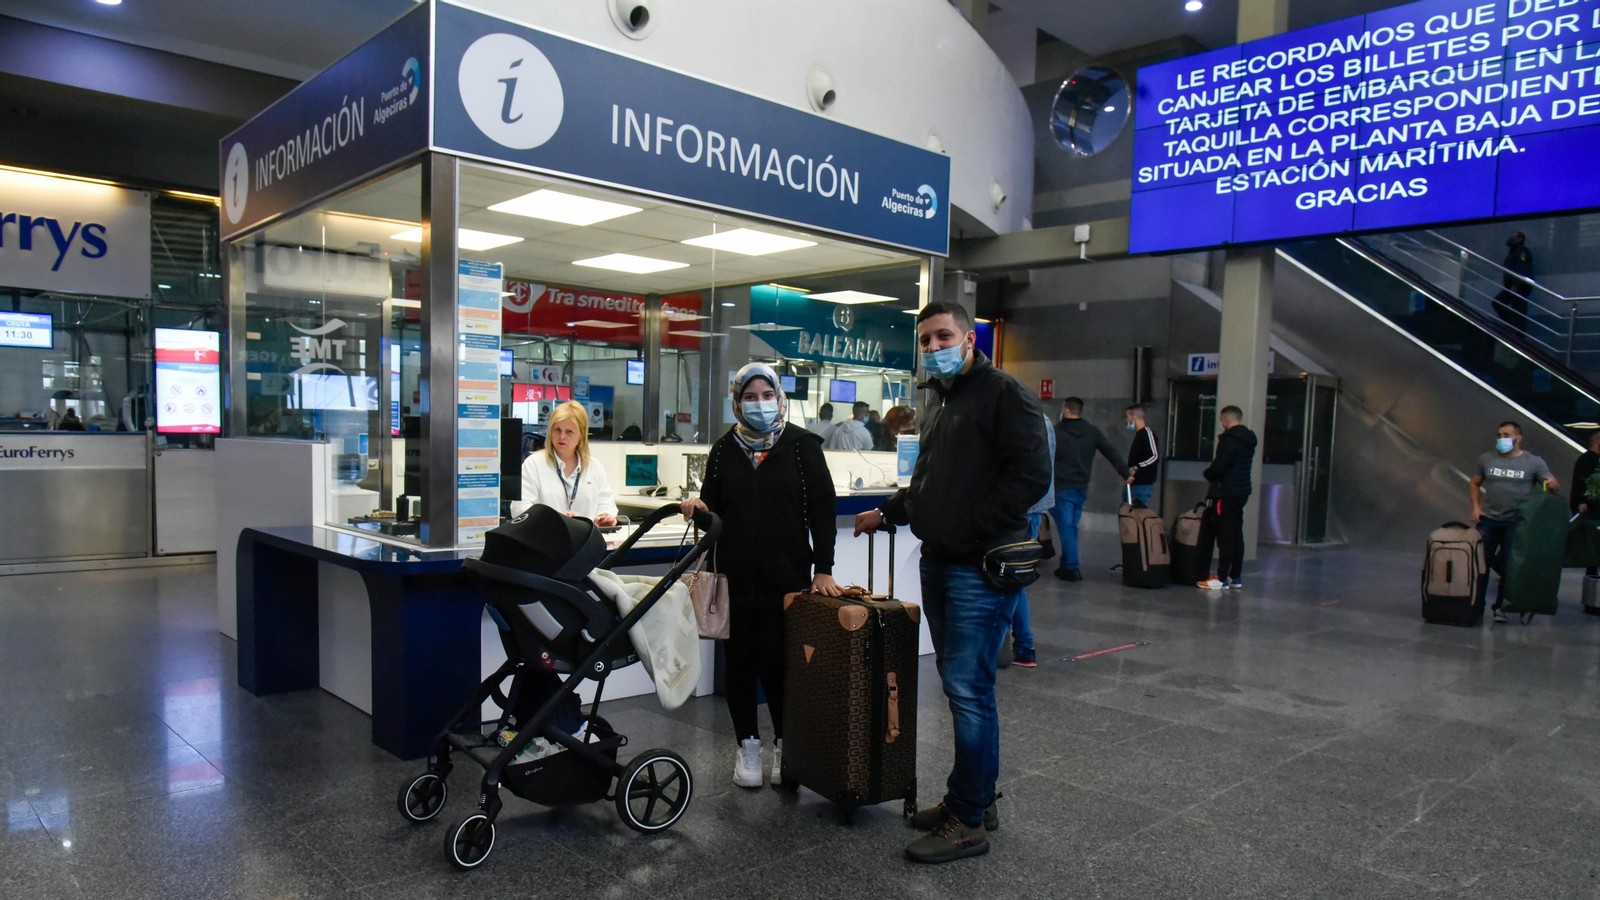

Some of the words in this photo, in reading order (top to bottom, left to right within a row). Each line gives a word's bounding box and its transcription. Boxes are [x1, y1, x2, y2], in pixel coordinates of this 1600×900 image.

[1158, 77, 1272, 115] CANJEAR
[1280, 64, 1335, 91] LOS
[1344, 32, 1490, 77] BILLETES
[1501, 14, 1580, 46] POR
[1177, 69, 1205, 90] LE
[1213, 22, 1415, 83] RECORDAMOS
[1425, 3, 1496, 35] QUE
[1508, 0, 1590, 18] DE
[373, 96, 408, 124] Algeciras
[381, 86, 399, 103] Puerto
[400, 80, 408, 91] de
[1165, 102, 1272, 135] TARJETA
[1278, 91, 1315, 115] DE
[1324, 55, 1502, 106] EMBARQUE
[1515, 44, 1563, 71] EN
[1576, 40, 1600, 60] L
[256, 95, 364, 192] INFORMACIÓN
[611, 103, 860, 205] INFORMACIÓN
[1138, 153, 1241, 183] SITUADA
[1247, 145, 1282, 166] EN
[1291, 139, 1324, 160] LA
[1331, 119, 1448, 153] PLANTA
[1455, 104, 1542, 134] BAJA
[1163, 123, 1282, 157] TAQUILLA
[1216, 158, 1349, 194] ESTACIÓN
[1360, 135, 1526, 174] MARÍTIMA.
[881, 196, 924, 218] Algeciras
[892, 187, 914, 202] Puerto
[915, 195, 924, 205] de
[1295, 177, 1428, 210] GRACIAS
[5, 330, 33, 339] 11:30
